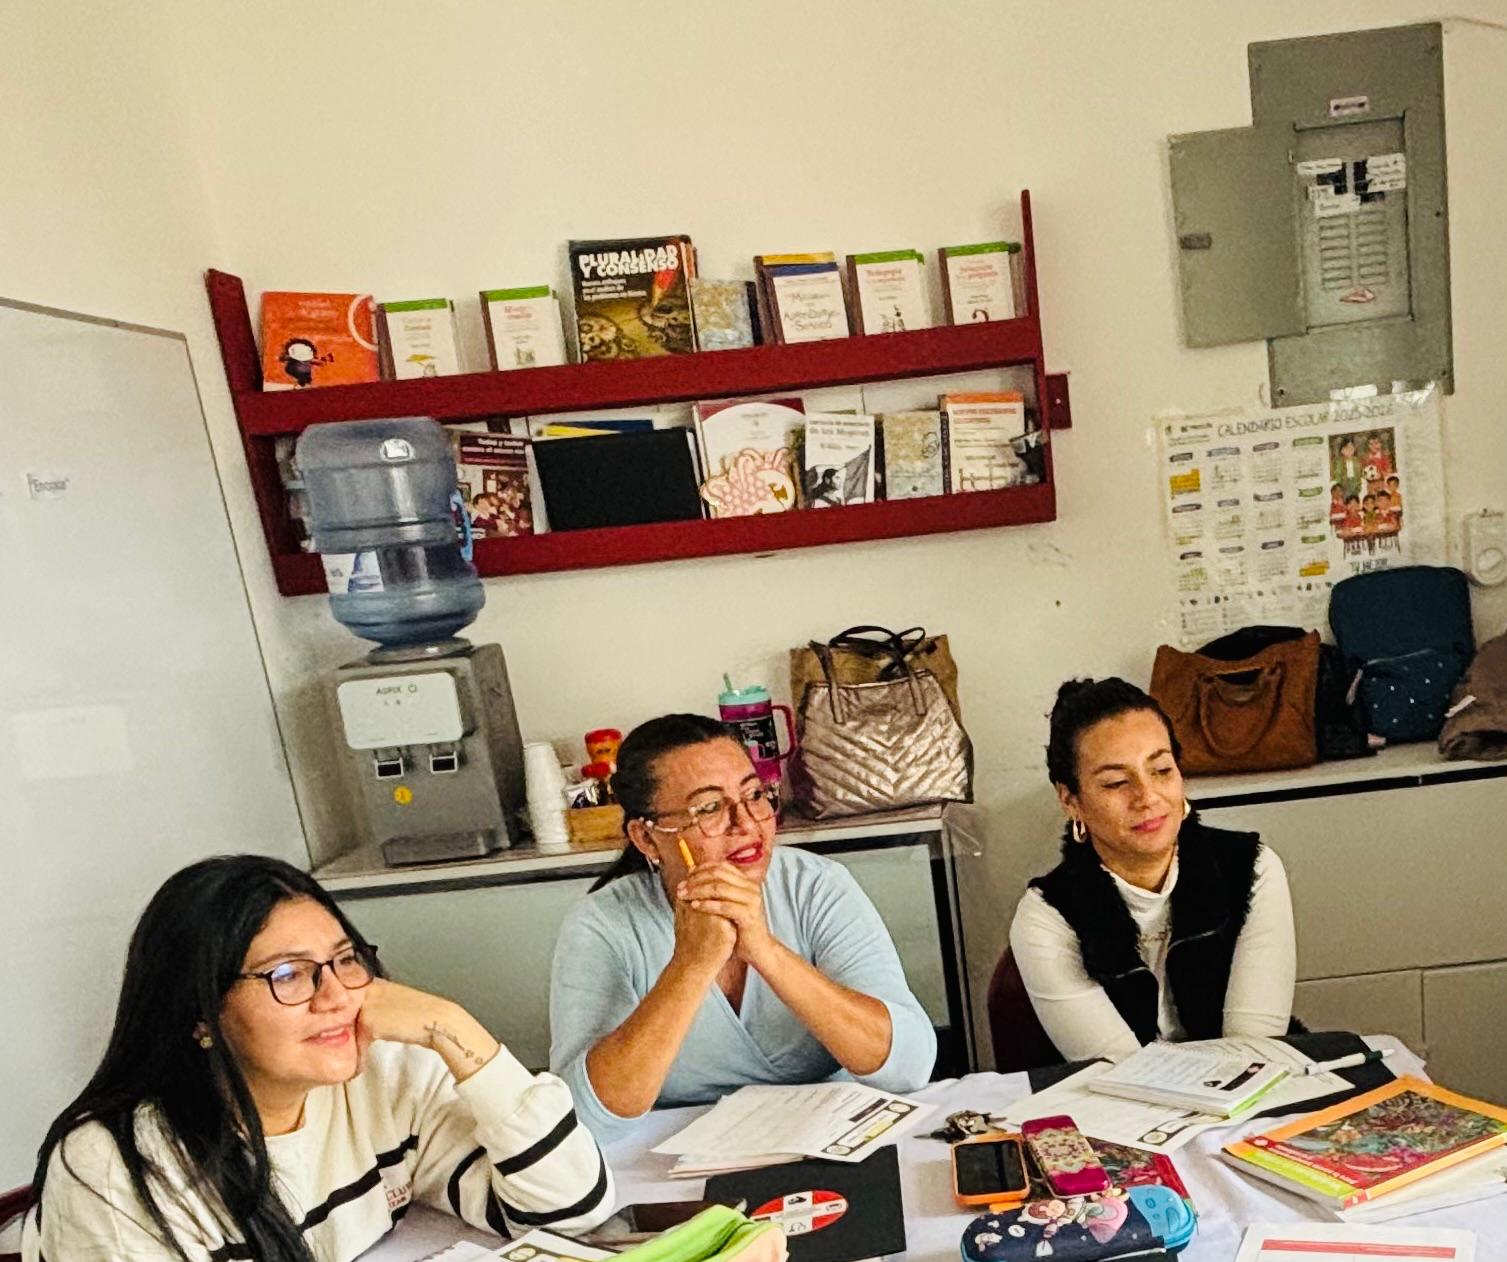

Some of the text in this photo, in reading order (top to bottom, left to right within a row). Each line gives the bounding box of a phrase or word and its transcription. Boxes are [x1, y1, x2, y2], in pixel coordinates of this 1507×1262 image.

[579, 244, 678, 266] PLURALIDAD
[579, 257, 679, 278] Y CONSENSO
